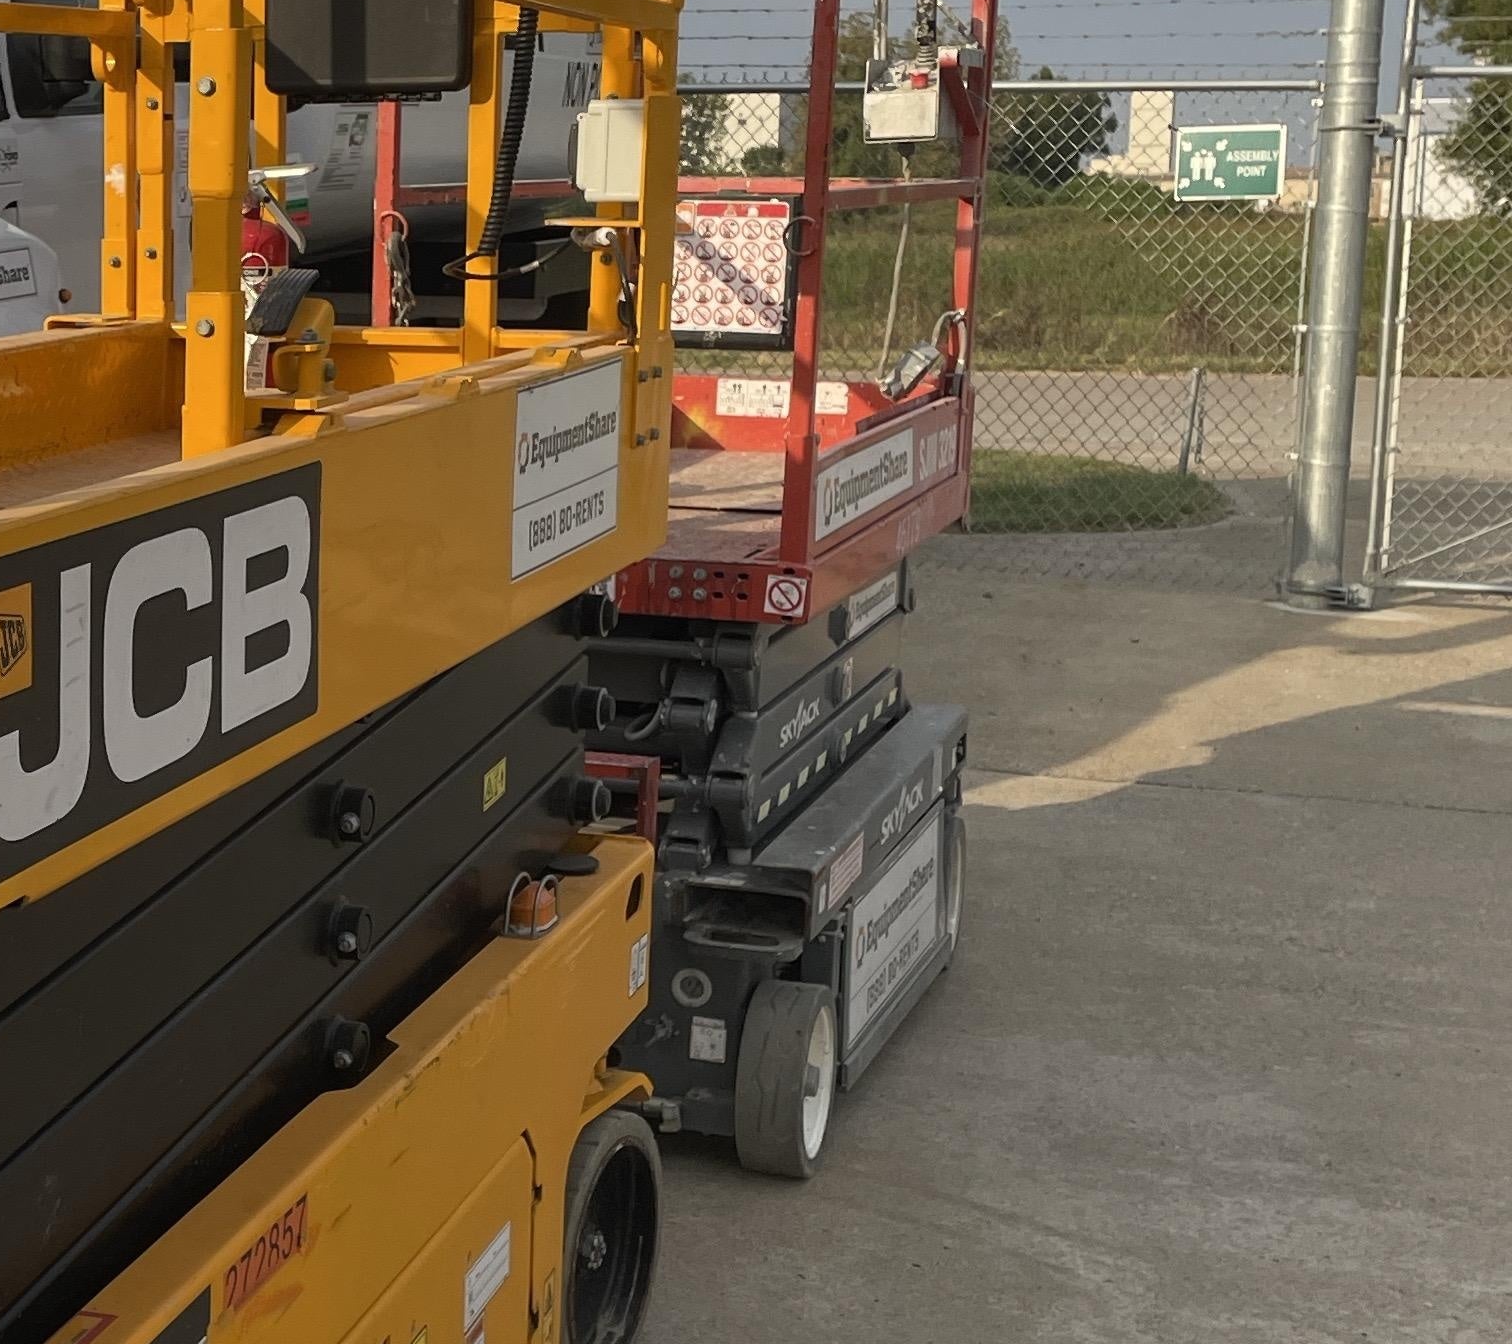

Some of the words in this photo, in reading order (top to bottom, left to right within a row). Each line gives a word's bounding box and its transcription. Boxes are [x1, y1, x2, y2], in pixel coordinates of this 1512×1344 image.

[1227, 150, 1279, 162] ASSEMBLY
[1236, 164, 1267, 177] POINT
[530, 411, 616, 468] EquipmentShare
[833, 450, 908, 518] EquipmentShare
[528, 510, 556, 551] (888)
[559, 490, 605, 535] 80-RENTS
[779, 696, 821, 748] SKYJACK
[880, 777, 924, 845] SKYJACK
[866, 857, 934, 954] EquipmentShare
